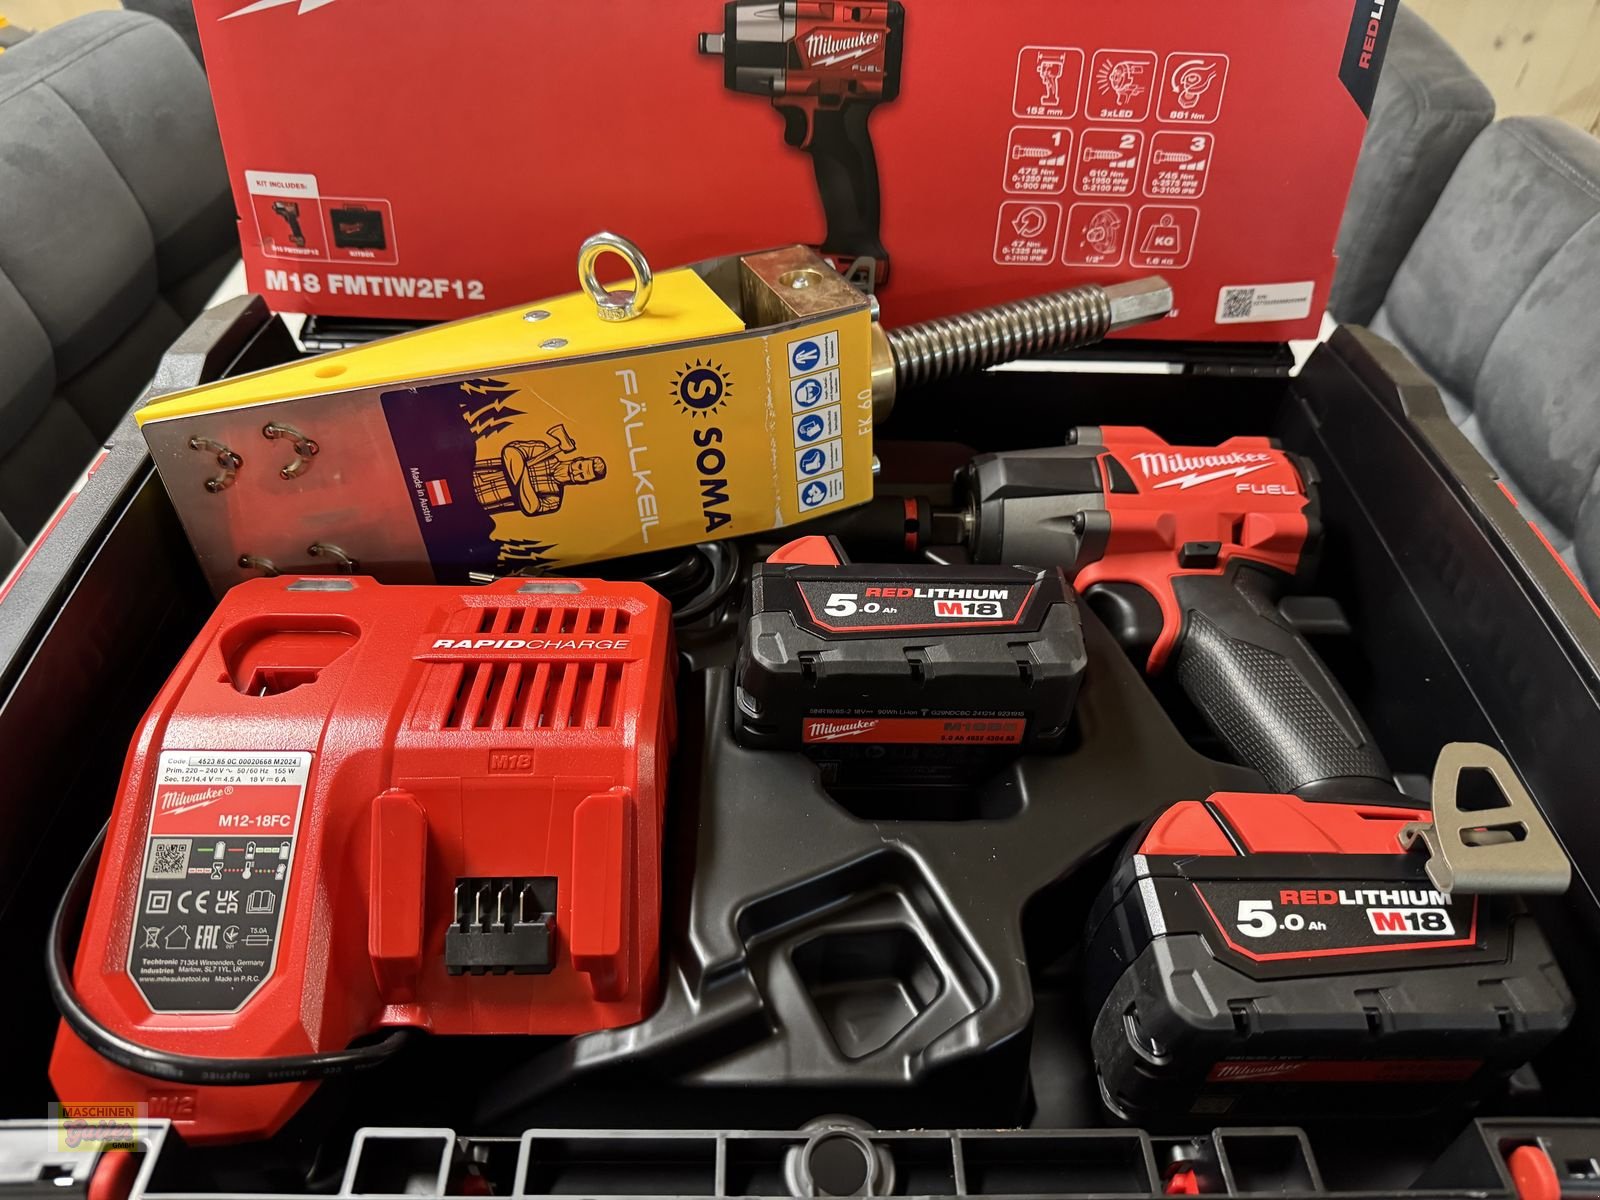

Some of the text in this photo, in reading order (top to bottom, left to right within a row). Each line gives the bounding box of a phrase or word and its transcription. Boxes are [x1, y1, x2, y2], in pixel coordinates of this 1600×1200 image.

[805, 31, 879, 58] Milwaukee
[851, 64, 881, 73] FUEL
[1047, 108, 1063, 116] mm
[1100, 109, 1133, 118] 3xLED
[1190, 112, 1205, 120] Nm
[1052, 132, 1061, 146] 1
[1120, 134, 1136, 149] 2
[1190, 136, 1206, 151] 3
[1110, 170, 1124, 178] Nm
[1180, 172, 1195, 180] Nm
[255, 180, 307, 190] KIT INCLUDES:
[1155, 236, 1174, 247] KG
[265, 269, 485, 301] M18 FMTIW2F12
[857, 388, 873, 410] 60
[615, 369, 659, 544] FÄLLKEIL
[1130, 451, 1272, 479] Milwaukee
[693, 427, 732, 533] SOMA
[410, 467, 433, 523] Made in Austria
[1236, 483, 1297, 495] FUEL
[865, 587, 1009, 600] REDLITHIUM
[823, 593, 881, 618] 5.0
[937, 602, 998, 616] M18
[432, 639, 630, 649] RAPIDCHARGE
[808, 719, 876, 737] Milwaukee
[491, 754, 532, 769] M18
[218, 815, 291, 827] M12-18FC
[177, 890, 210, 914] CE
[216, 890, 240, 902] UK
[1279, 889, 1452, 905] REDLITHIUM
[215, 902, 239, 914] CA
[1236, 900, 1327, 938] 5.0 Ah
[1372, 912, 1447, 931] M18
[236, 959, 265, 967] Germany
